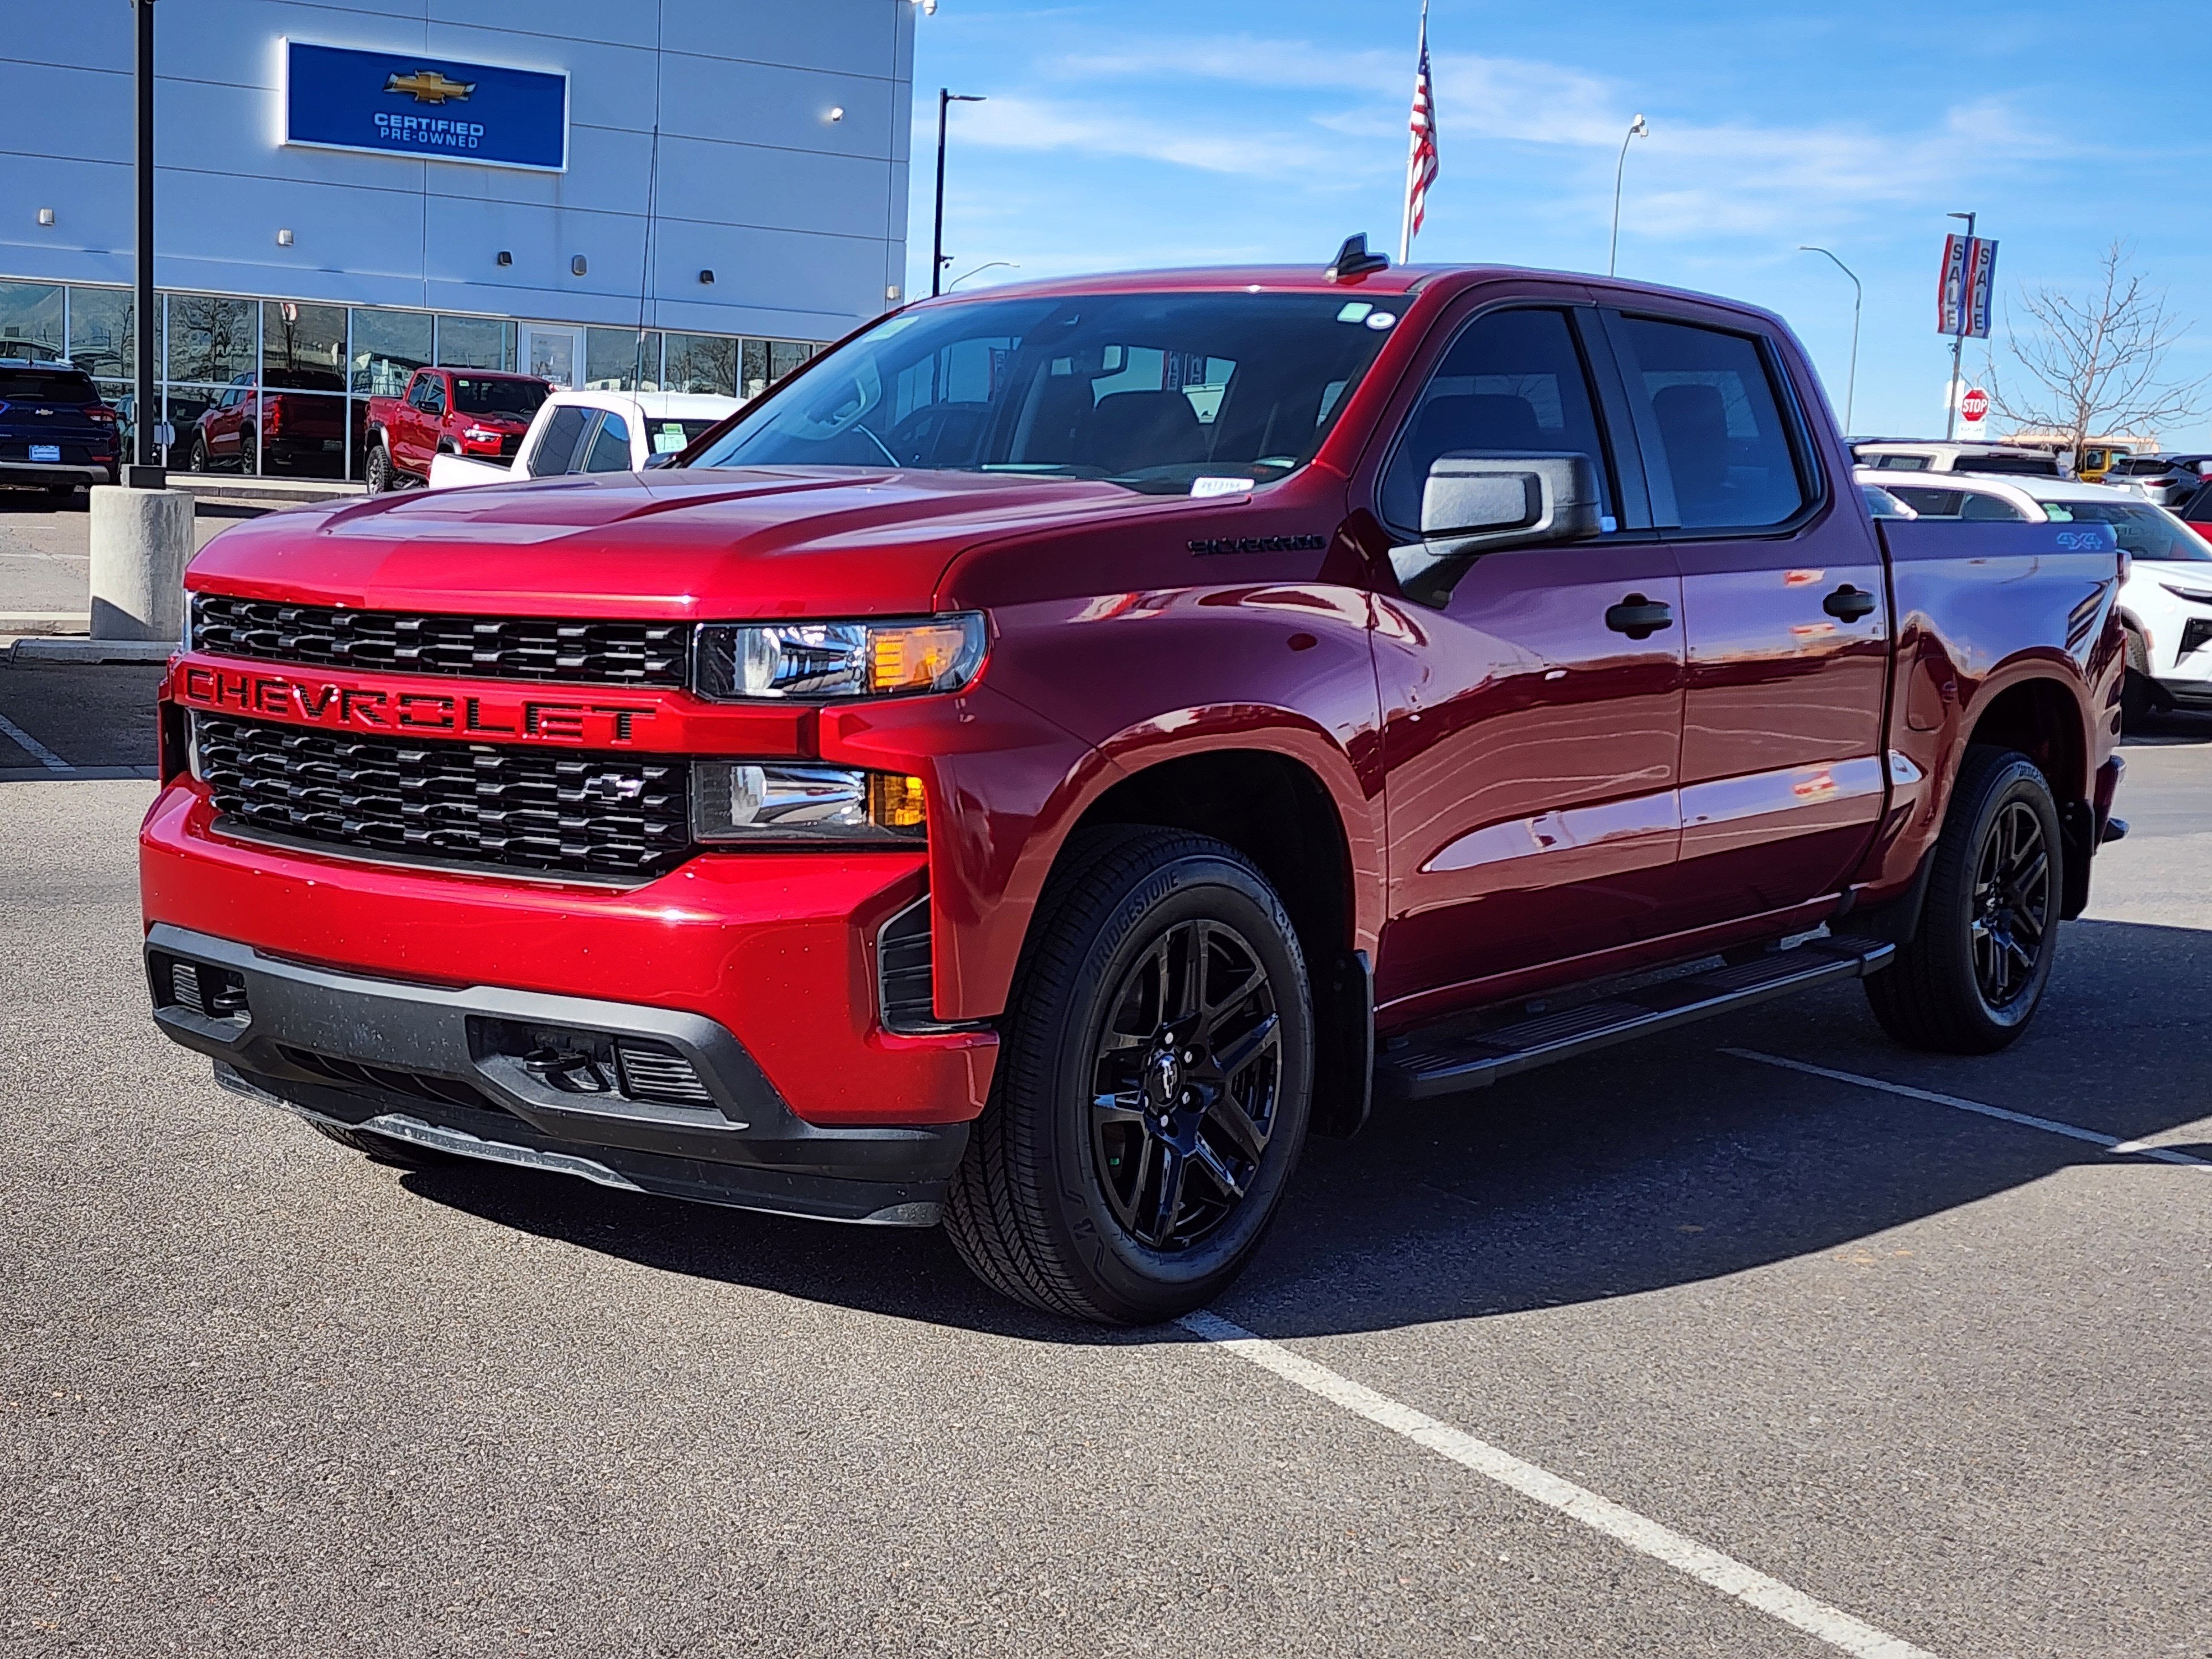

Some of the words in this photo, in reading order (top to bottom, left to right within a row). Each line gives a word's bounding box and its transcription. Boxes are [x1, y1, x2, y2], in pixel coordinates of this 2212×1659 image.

[374, 113, 484, 137] CERTIFIED
[380, 128, 478, 149] PRE-OWNED
[1947, 243, 1964, 327] SALE
[1974, 248, 1990, 330] SALE
[1962, 398, 1988, 413] STOP
[1186, 534, 1327, 557] SILVERADO
[183, 667, 662, 746] CHEVROLET
[1086, 868, 1180, 984] BRIDGESTONE
